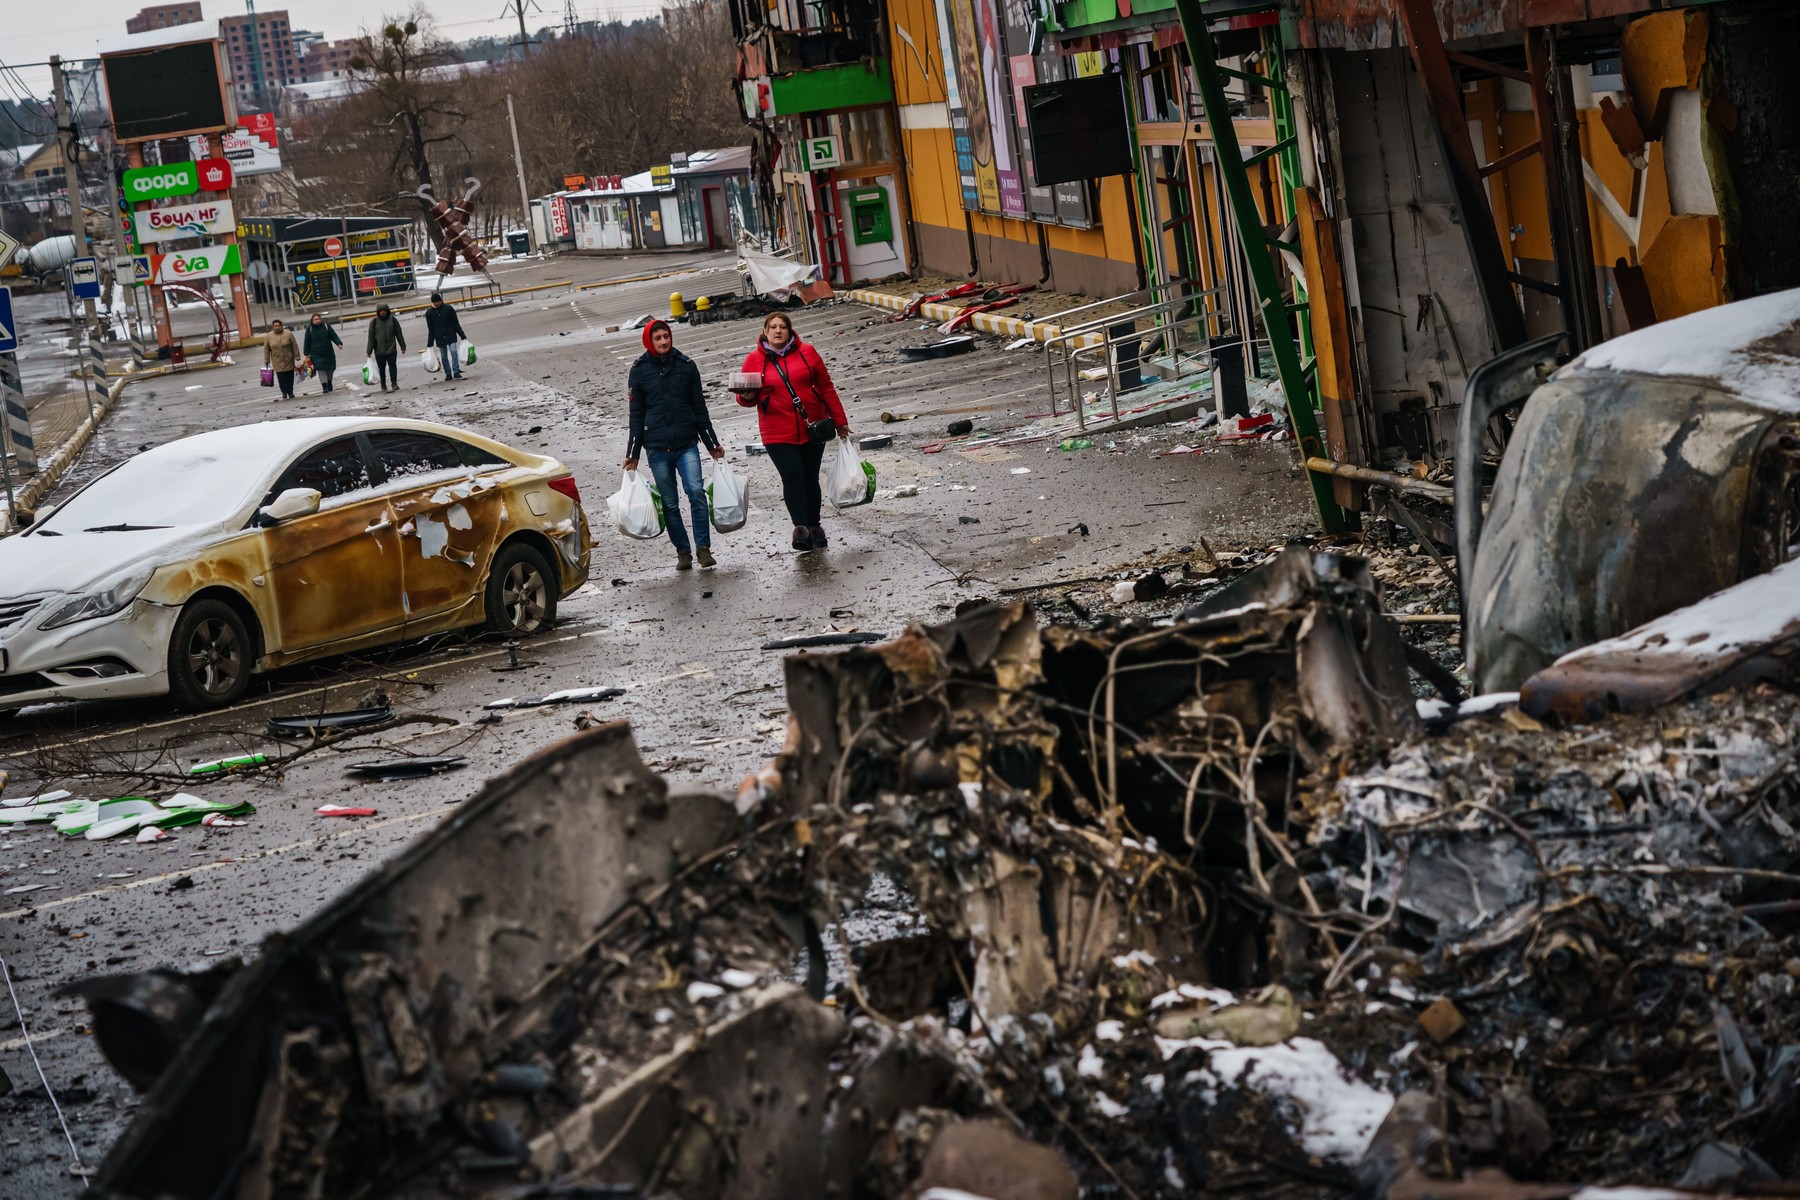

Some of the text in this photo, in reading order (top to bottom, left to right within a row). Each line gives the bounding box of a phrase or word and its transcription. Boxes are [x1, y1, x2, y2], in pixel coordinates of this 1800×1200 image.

[133, 172, 189, 192] фора
[551, 202, 562, 233] АВТО
[559, 199, 569, 234] ЗАПЧАСТИ
